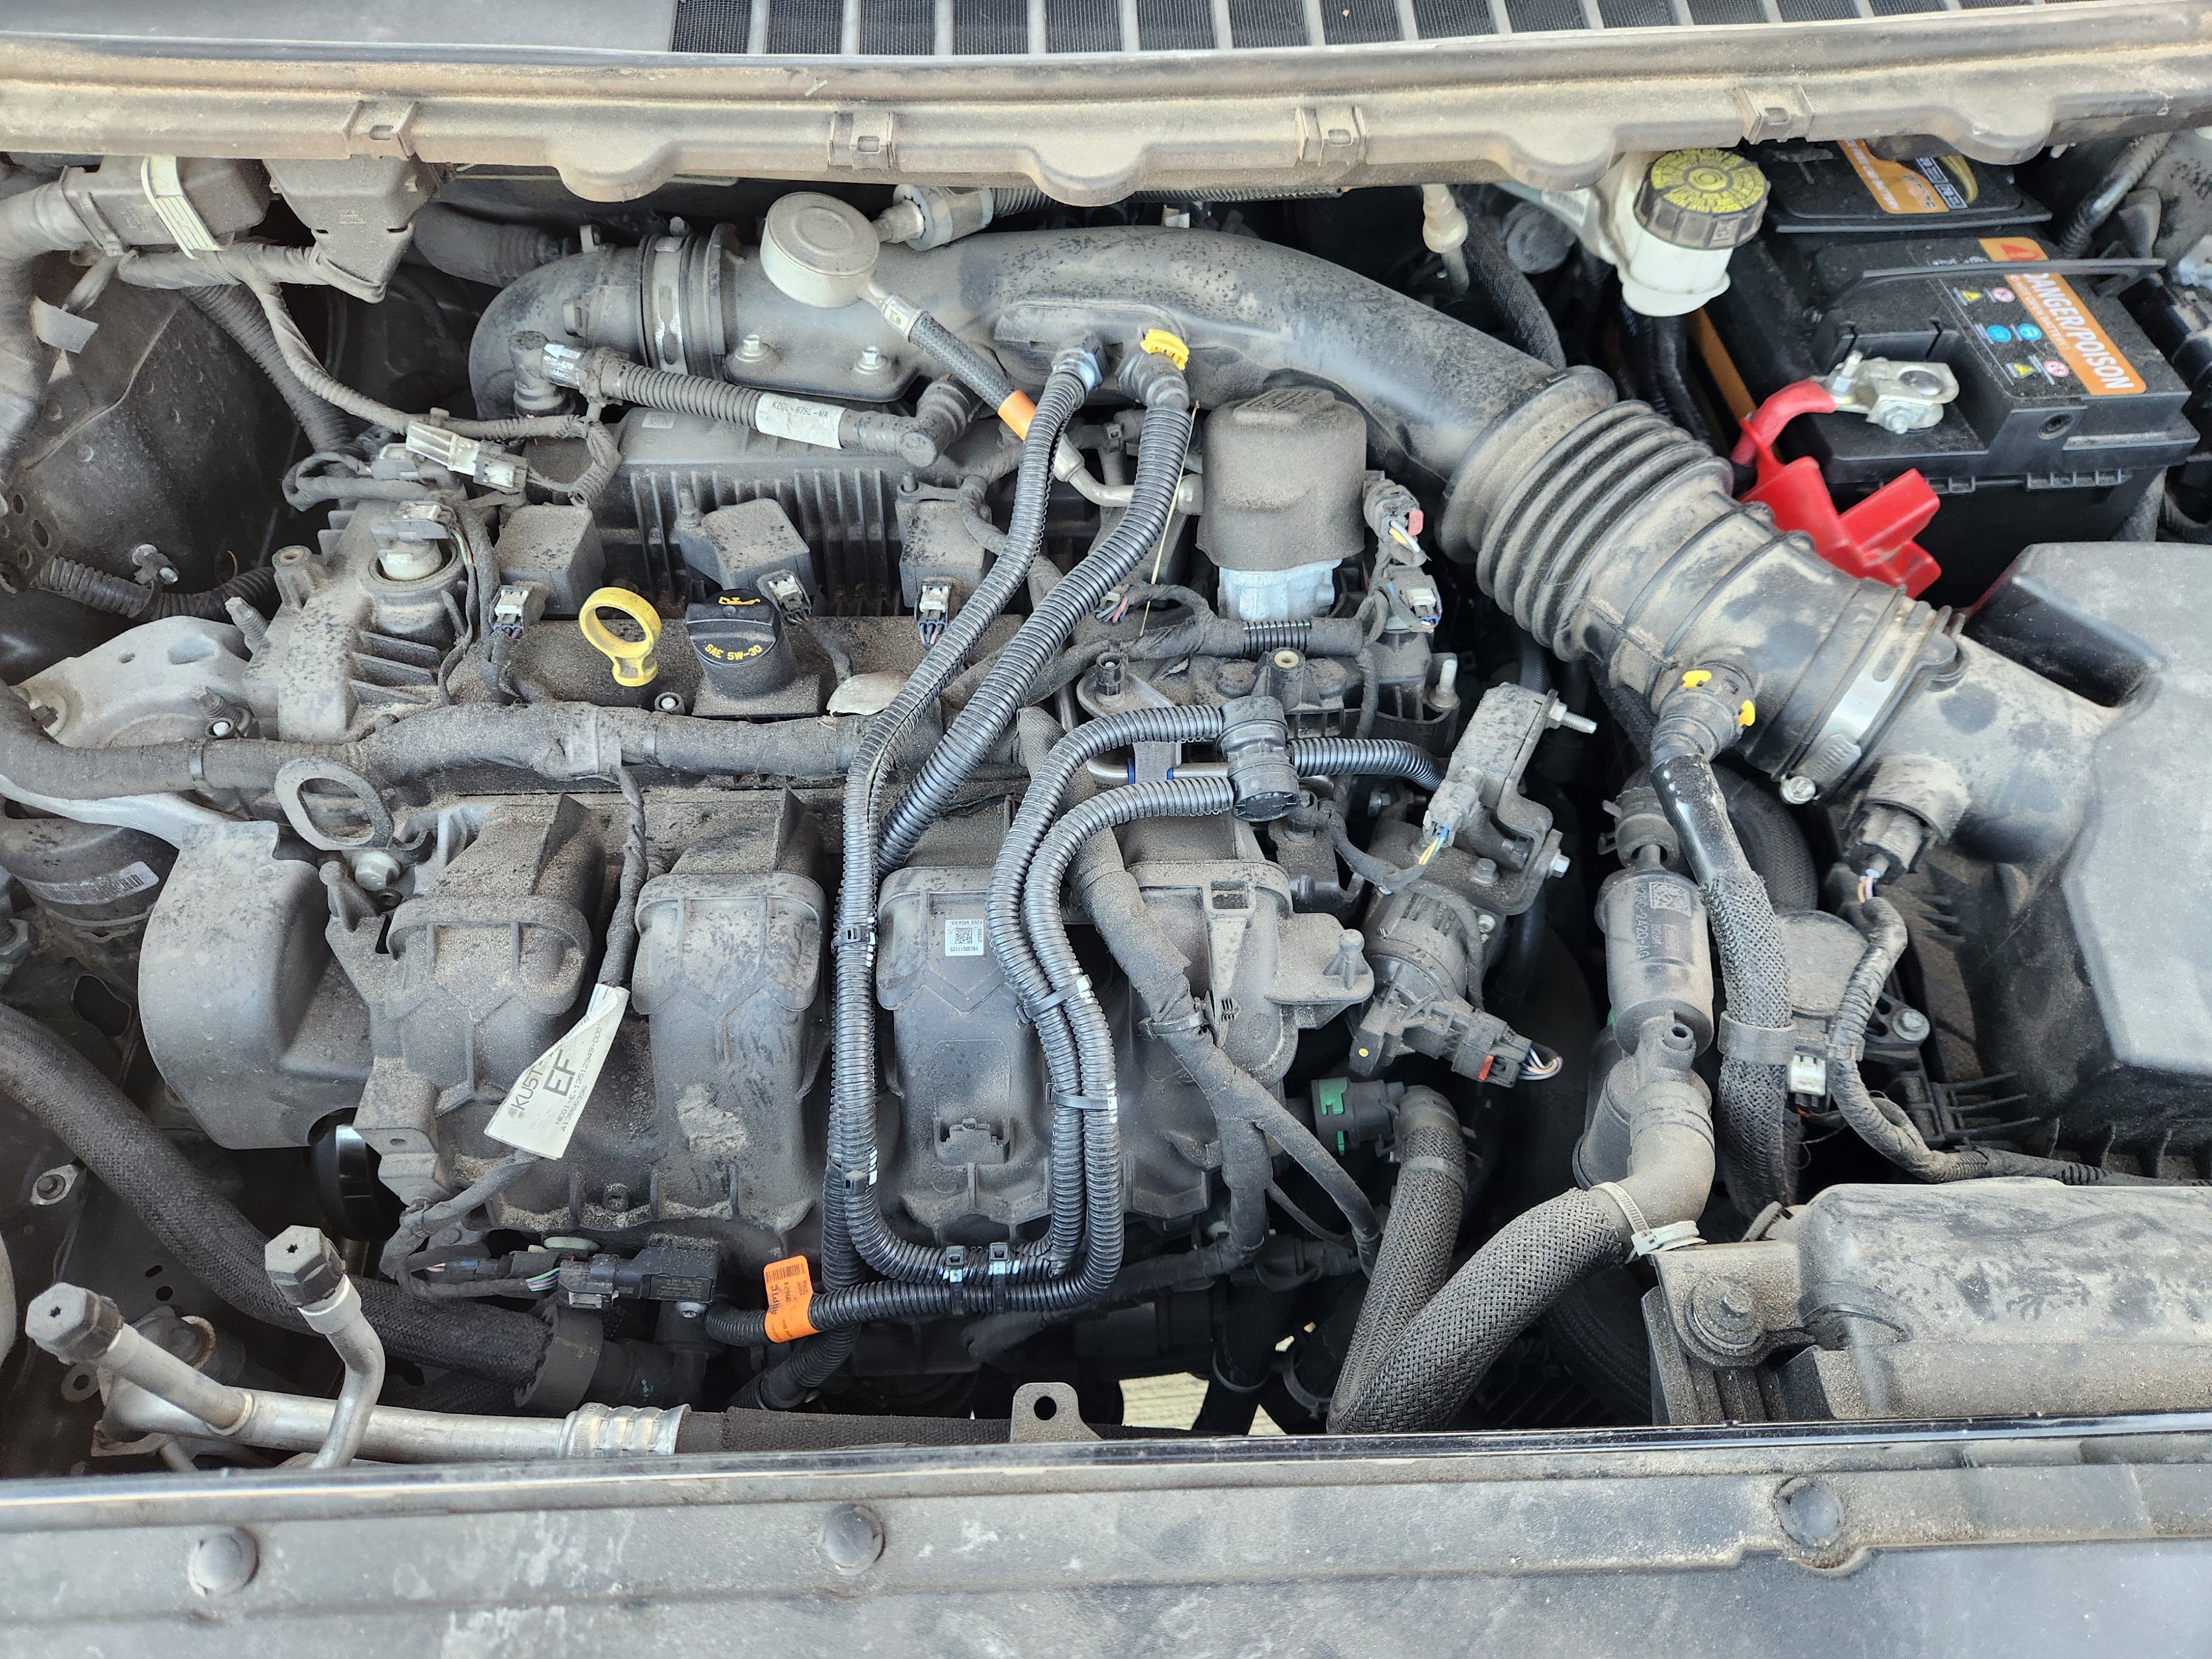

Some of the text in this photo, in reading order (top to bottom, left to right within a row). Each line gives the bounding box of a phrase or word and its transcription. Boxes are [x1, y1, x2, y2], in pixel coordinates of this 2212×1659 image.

[705, 644, 763, 660] SAE 5W-30
[542, 1048, 576, 1097] EF
